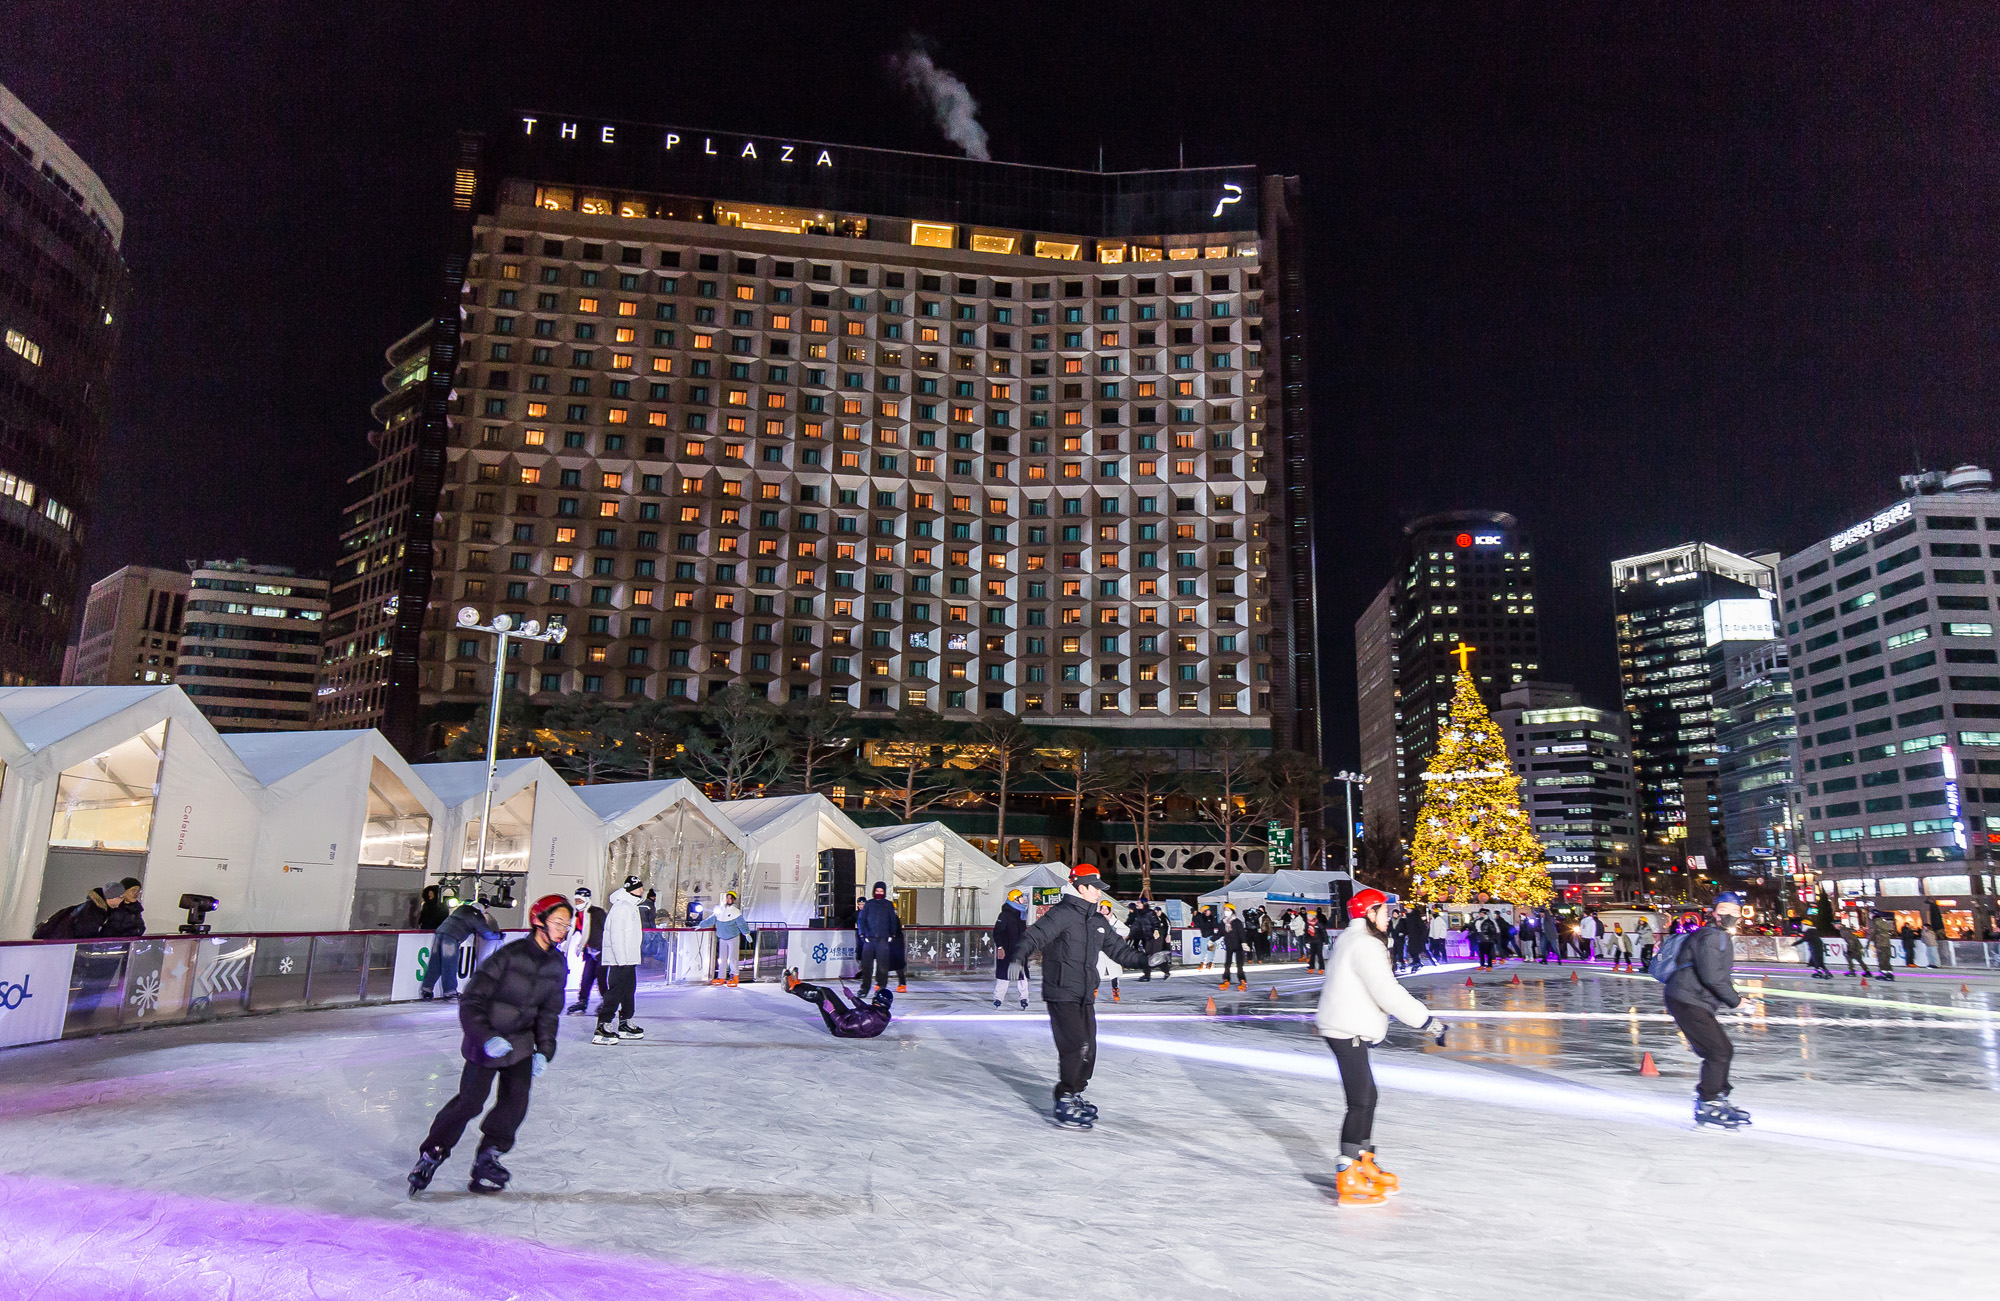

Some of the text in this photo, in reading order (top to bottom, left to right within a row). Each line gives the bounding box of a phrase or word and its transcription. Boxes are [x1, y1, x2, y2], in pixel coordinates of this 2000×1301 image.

[523, 117, 833, 168] THE PLAZA
[1871, 501, 1913, 532] 경동대학교
[1474, 535, 1502, 545] ICBC
[1418, 768, 1506, 782] Merry Christmas
[177, 805, 193, 851] Cafeteria
[829, 947, 855, 957] 서울특별
